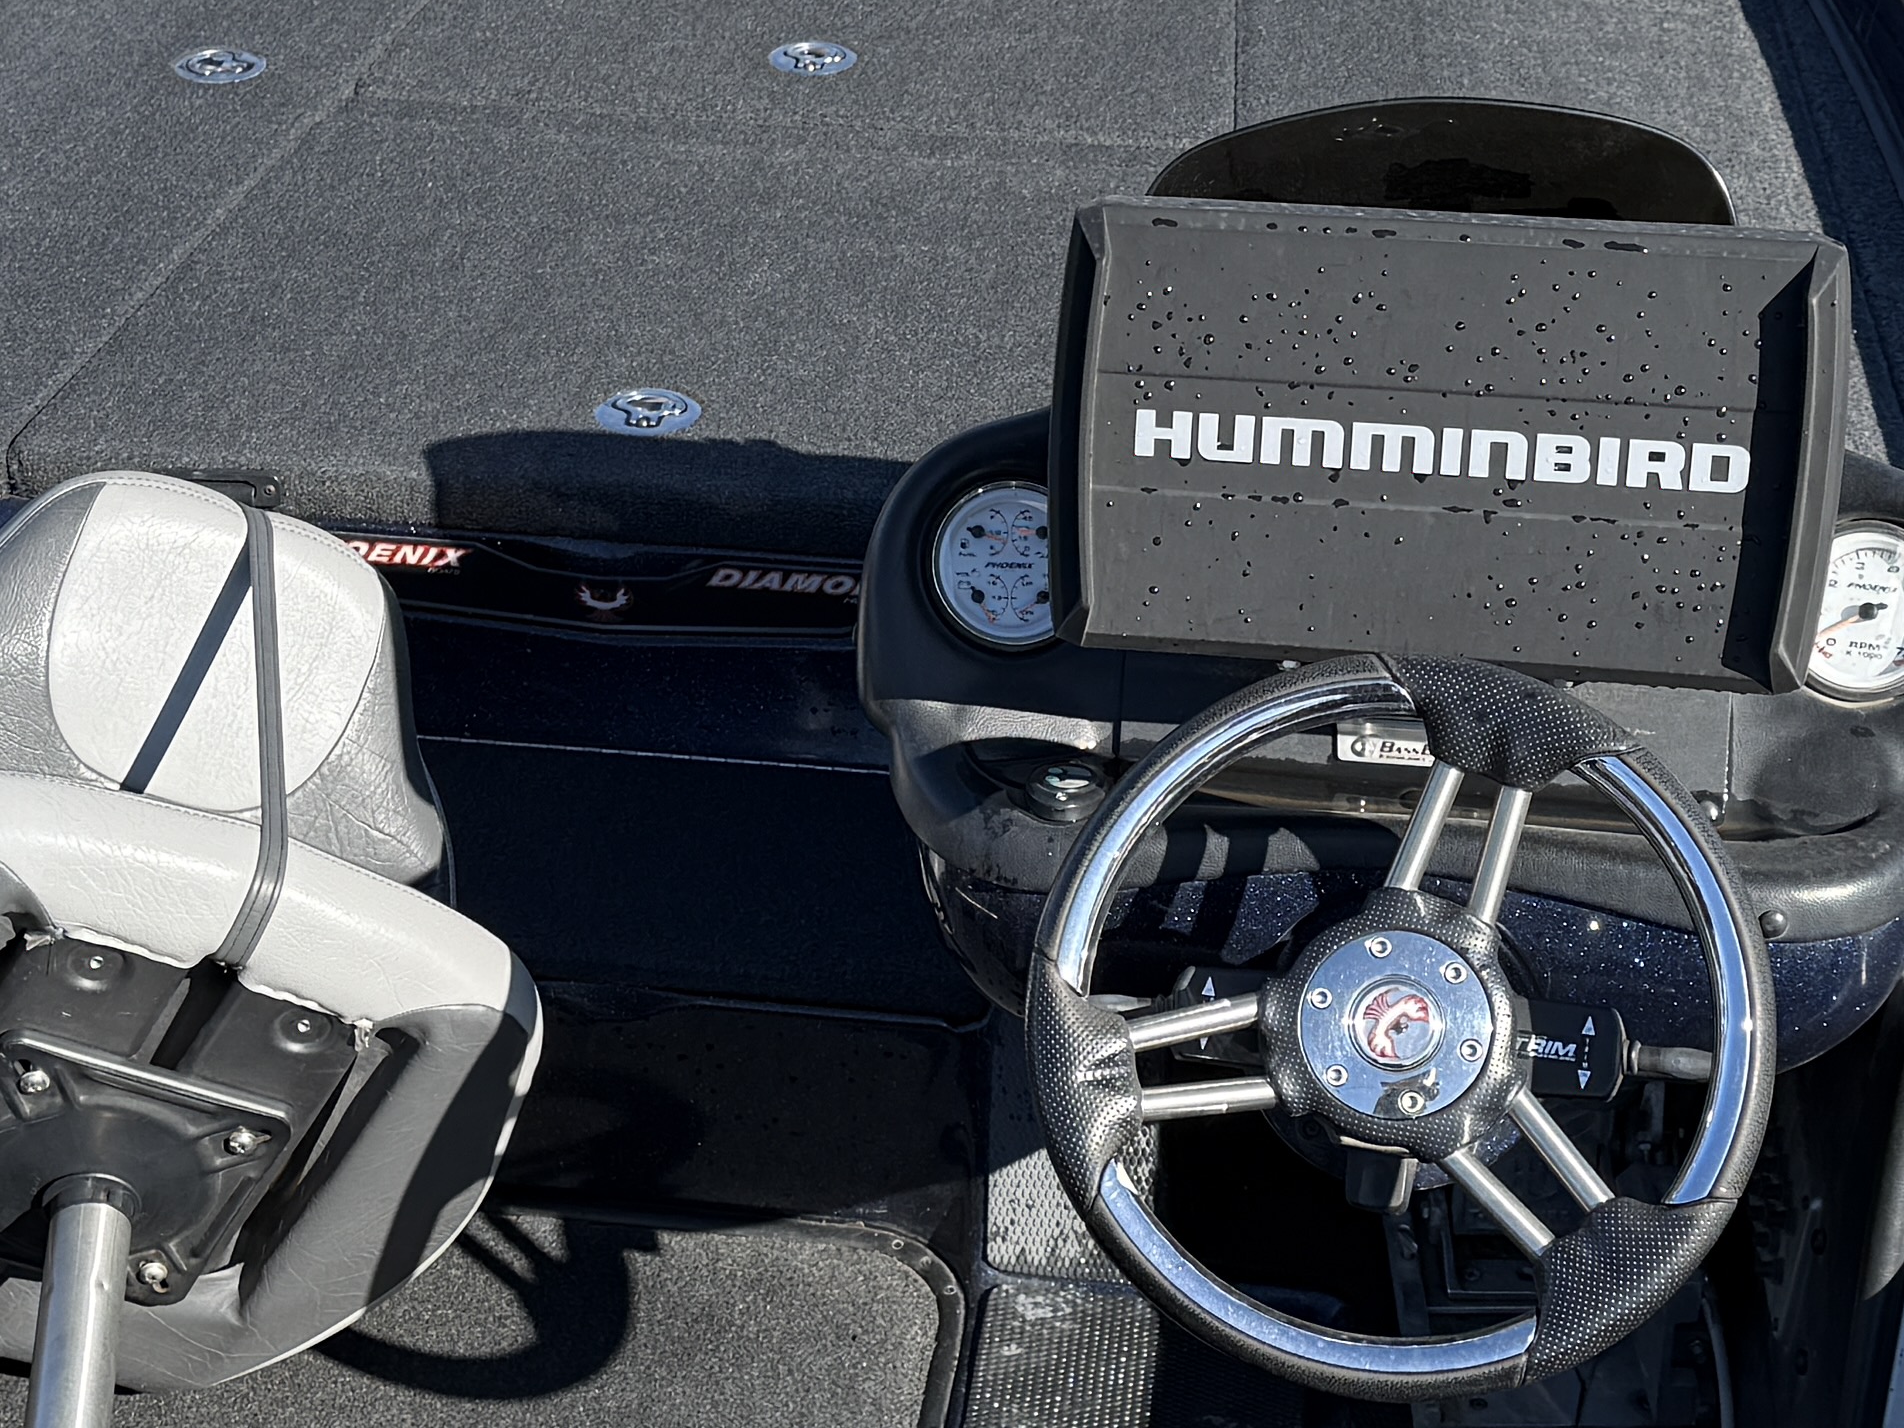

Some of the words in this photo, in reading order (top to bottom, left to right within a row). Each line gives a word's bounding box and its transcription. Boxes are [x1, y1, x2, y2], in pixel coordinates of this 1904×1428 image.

[1134, 409, 1751, 493] HUMMINBIRD
[347, 540, 475, 568] OENIX
[704, 567, 860, 596] DIAMO
[1848, 640, 1881, 652] RPM
[1516, 1035, 1577, 1057] TRIM
